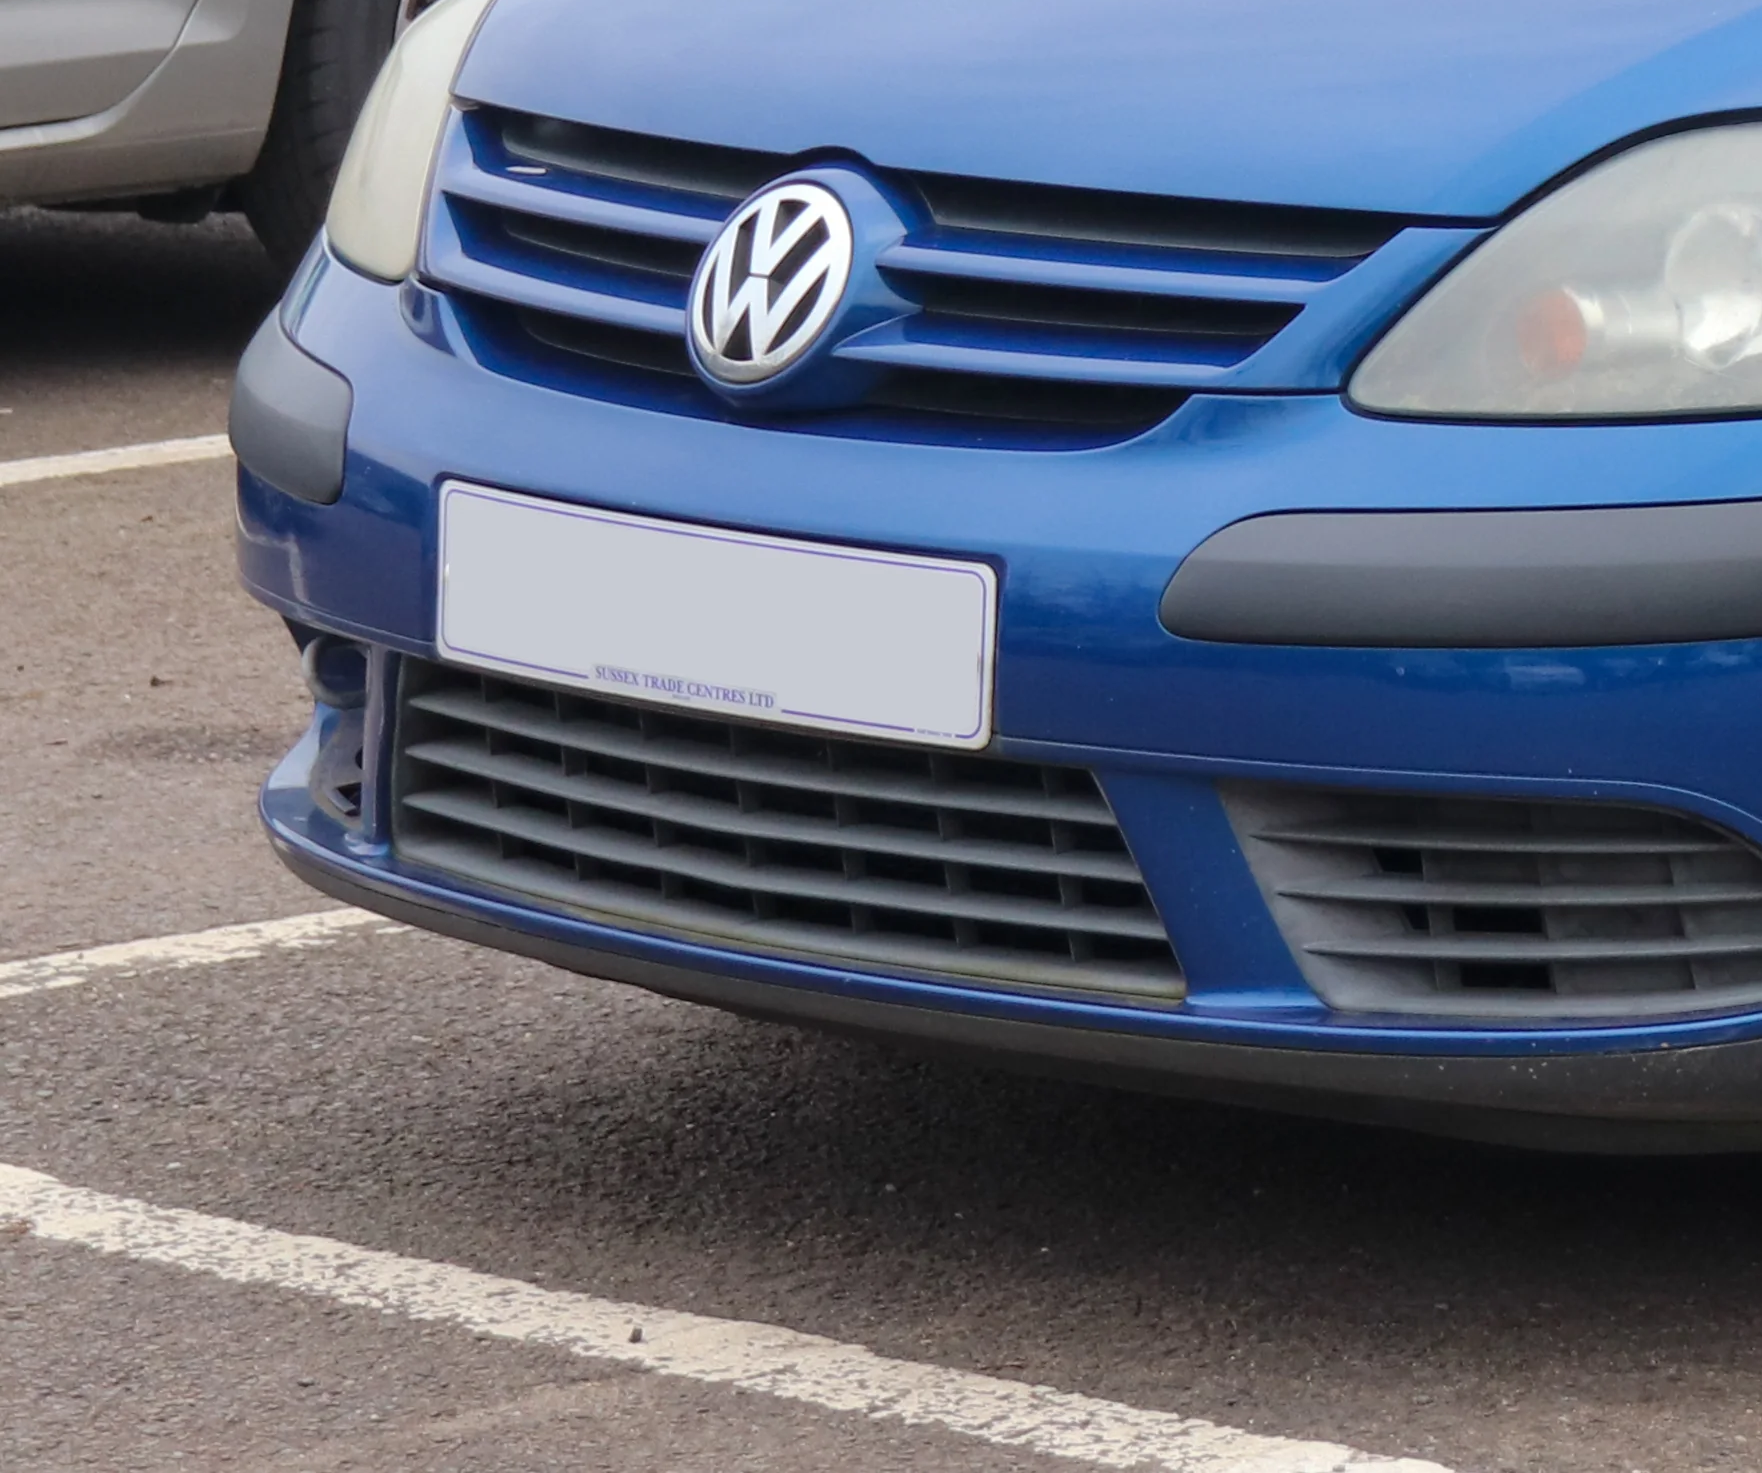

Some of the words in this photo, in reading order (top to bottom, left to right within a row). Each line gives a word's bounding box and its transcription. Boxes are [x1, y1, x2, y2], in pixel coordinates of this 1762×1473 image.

[692, 183, 851, 383] VW
[594, 665, 641, 687] SUSSEX
[643, 674, 684, 694] TRADE
[687, 682, 746, 704] CENTRES
[749, 692, 775, 709] LTD
